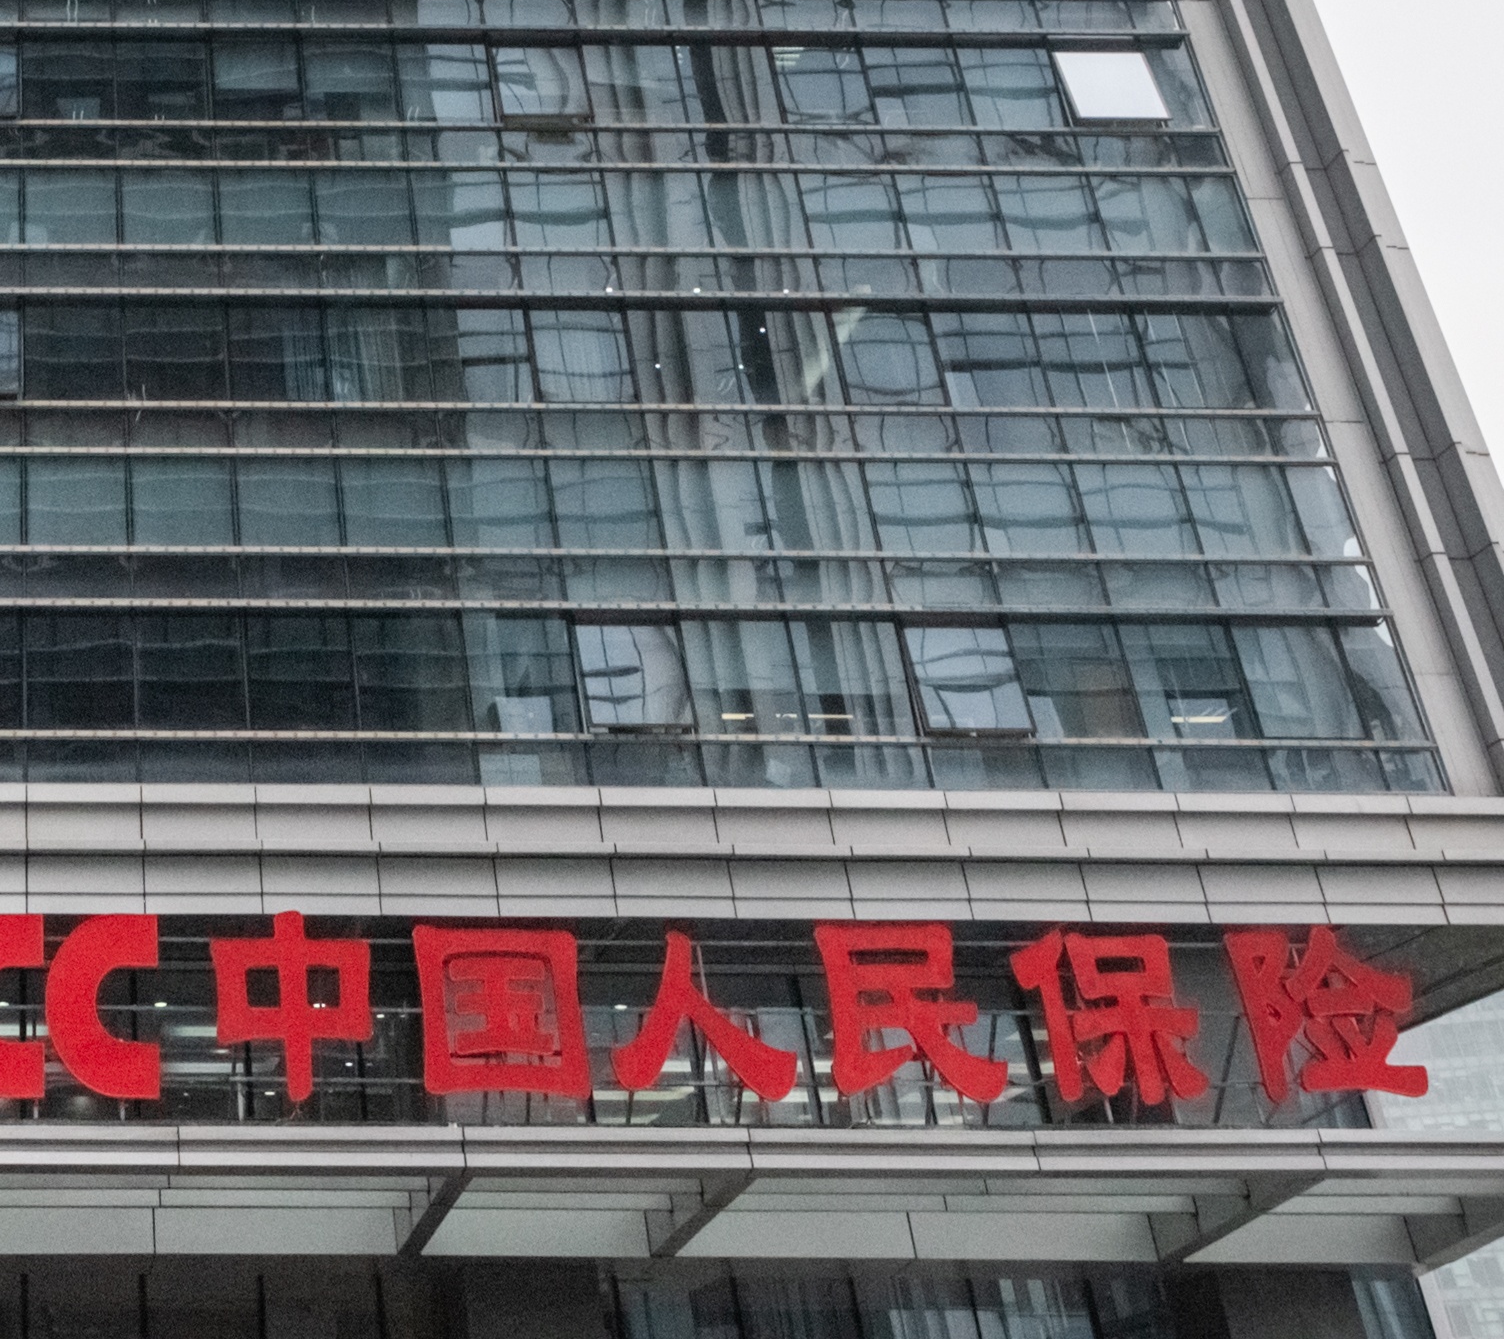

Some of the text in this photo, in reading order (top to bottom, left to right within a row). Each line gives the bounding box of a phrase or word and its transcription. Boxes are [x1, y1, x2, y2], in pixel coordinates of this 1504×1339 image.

[208, 910, 1429, 1106] 中国人民保险
